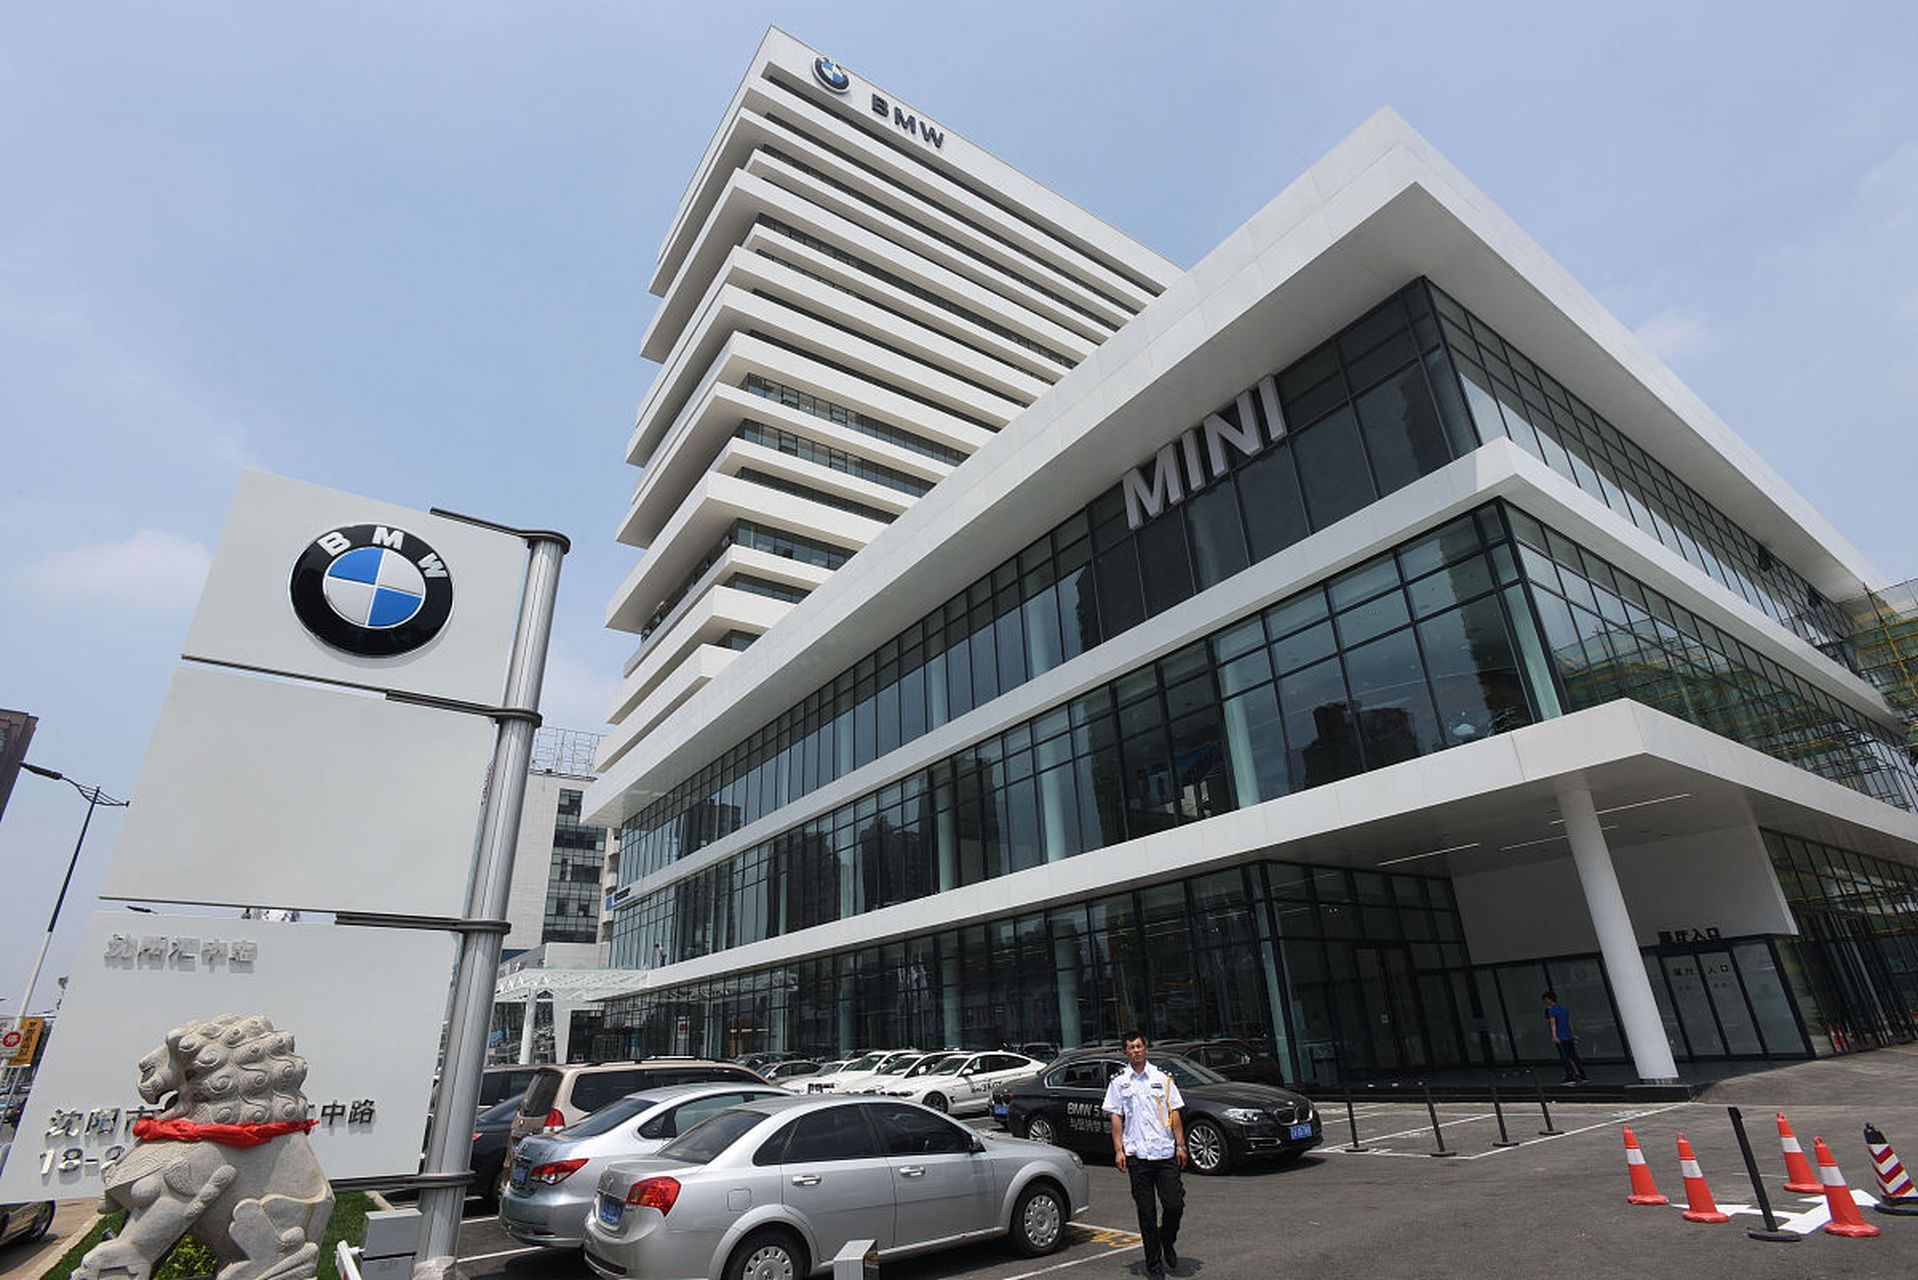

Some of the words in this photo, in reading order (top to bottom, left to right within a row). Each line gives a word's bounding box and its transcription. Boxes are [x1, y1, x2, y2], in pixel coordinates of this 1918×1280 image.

[871, 93, 944, 149] BMW
[1122, 373, 1288, 531] MINI
[317, 526, 448, 579] BMW
[1067, 1102, 1092, 1116] BMW
